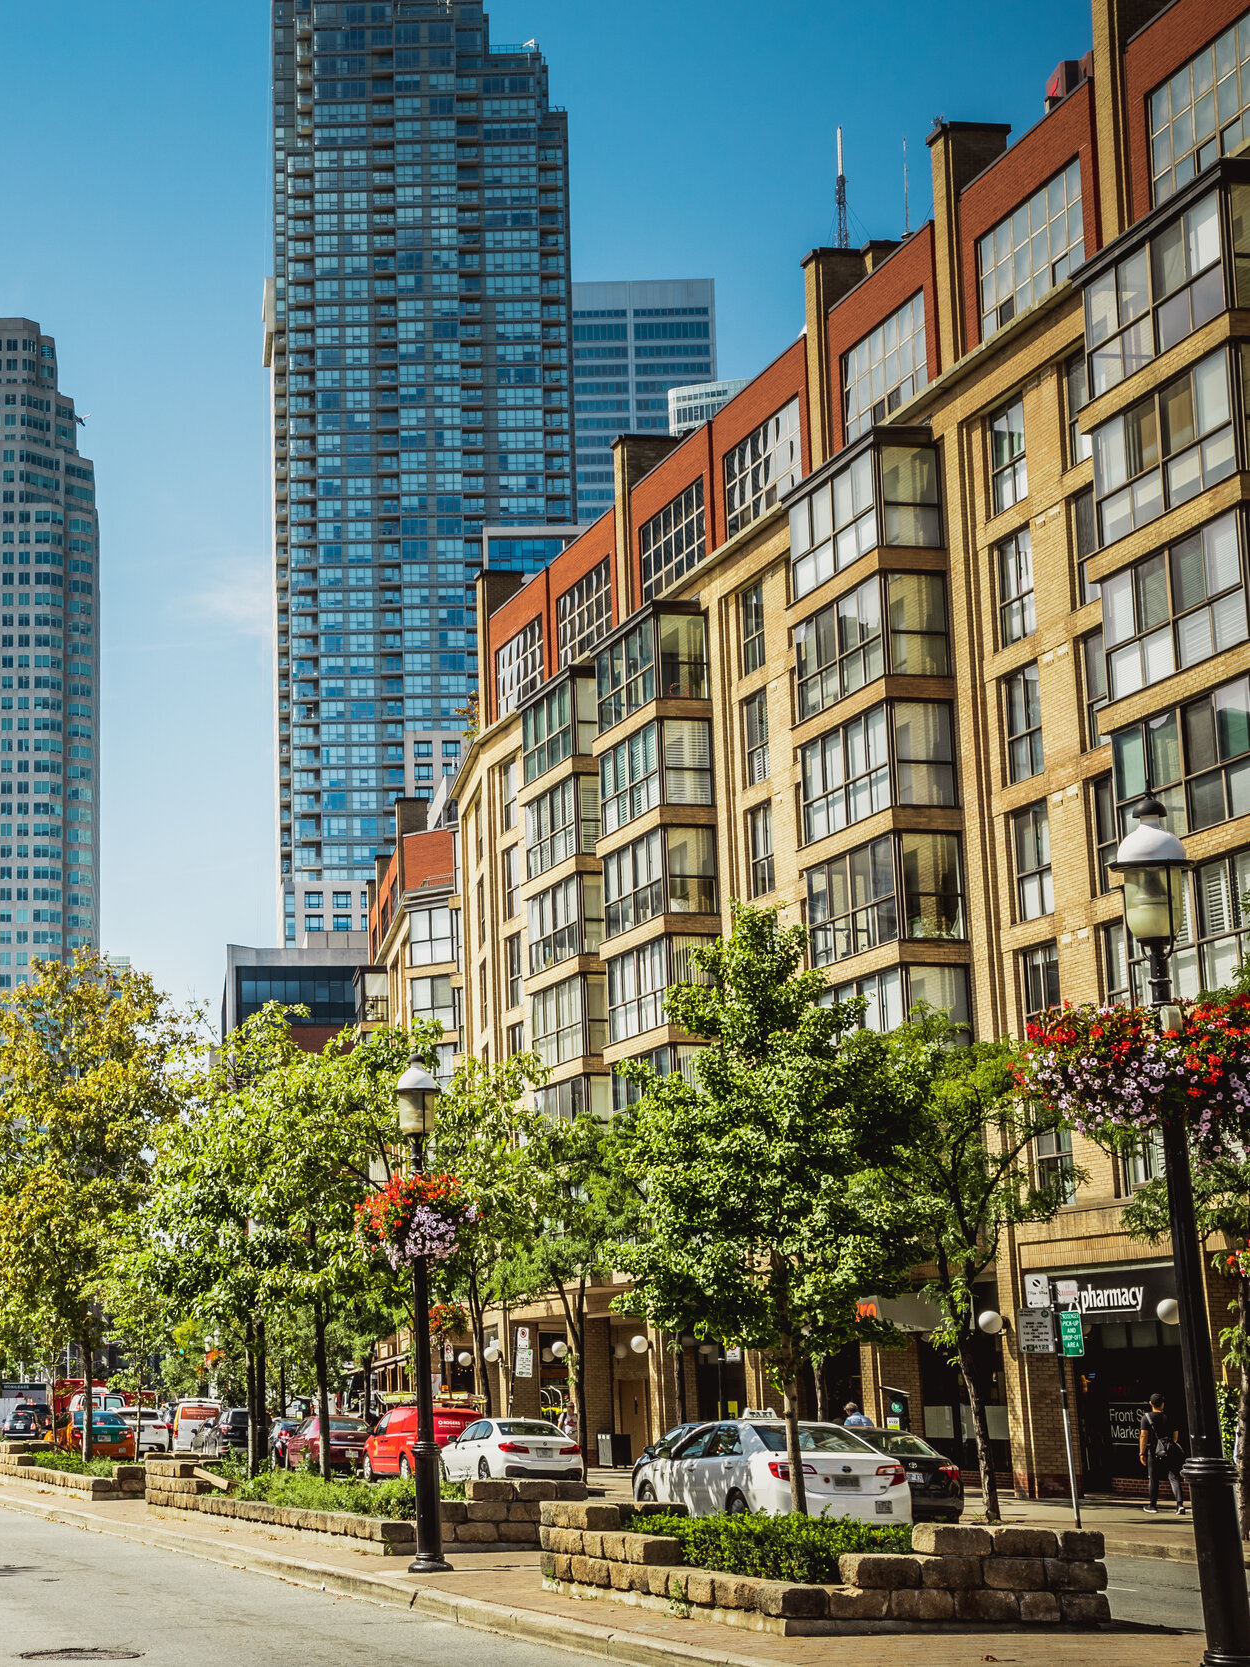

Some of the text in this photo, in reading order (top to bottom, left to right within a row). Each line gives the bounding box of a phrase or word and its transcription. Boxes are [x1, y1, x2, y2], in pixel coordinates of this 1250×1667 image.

[1081, 1284, 1144, 1314] pharmacy
[1109, 1409, 1134, 1422] Front
[1111, 1426, 1140, 1439] Marke
